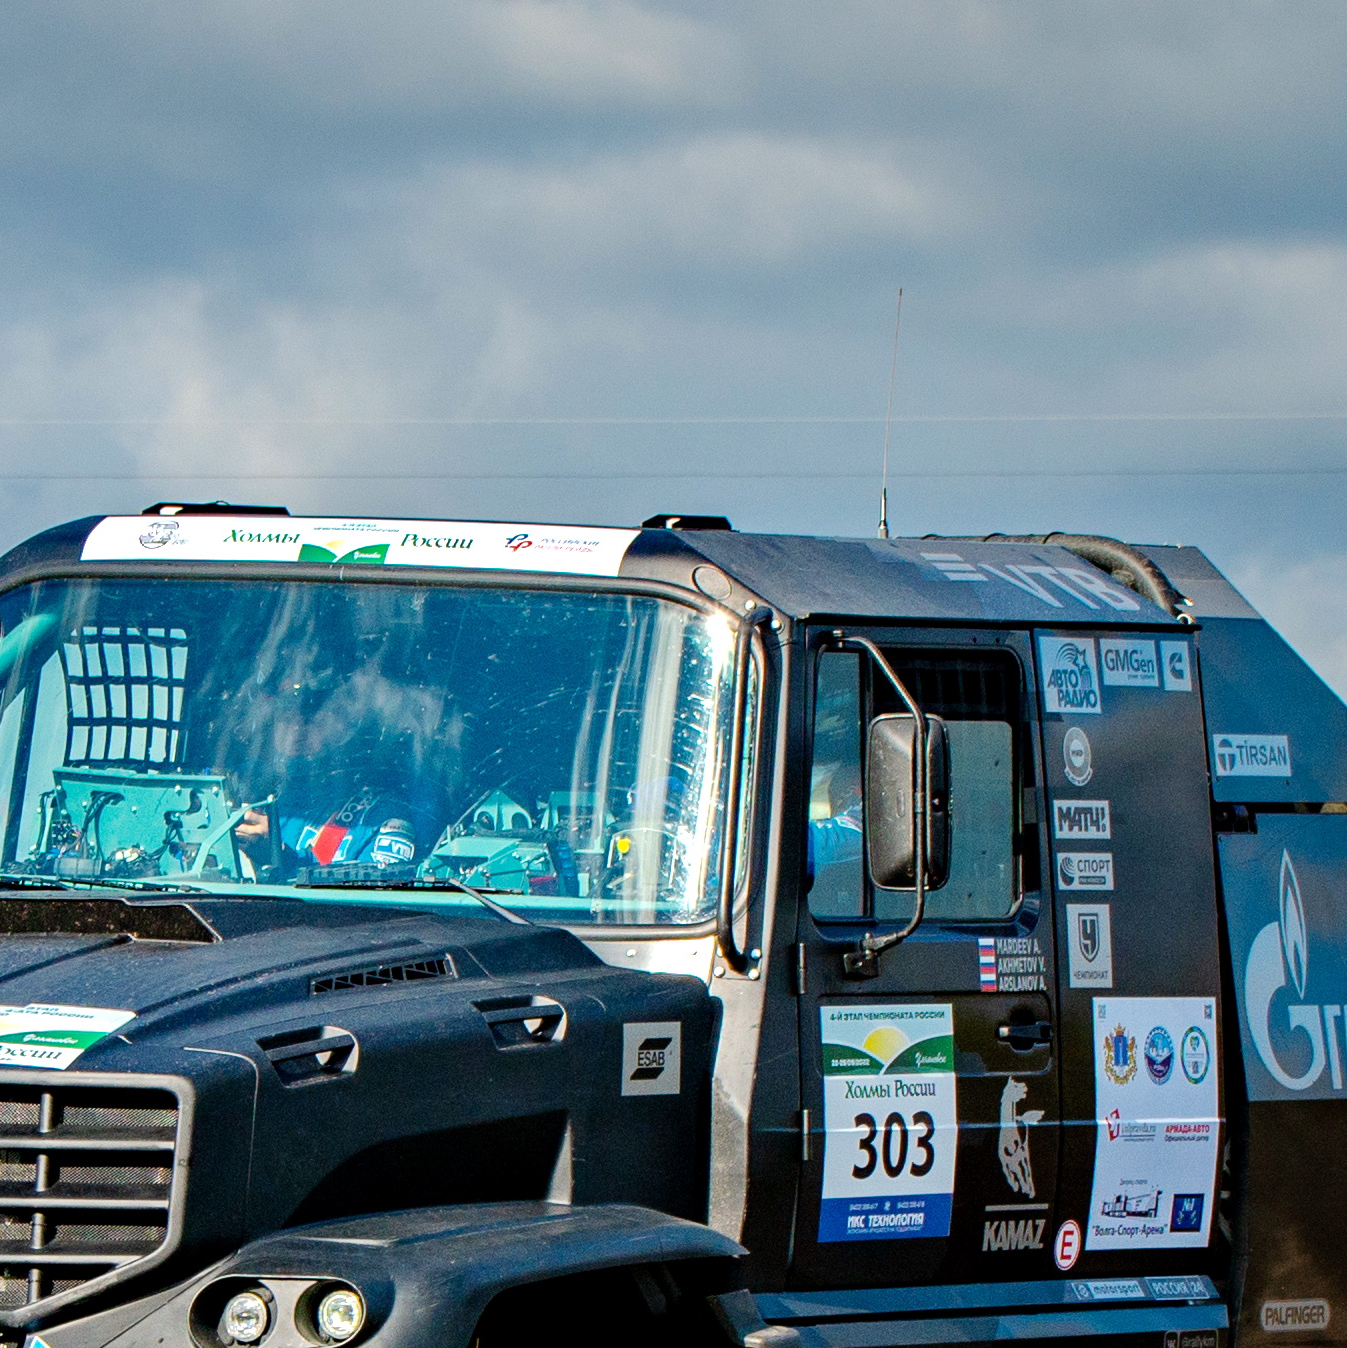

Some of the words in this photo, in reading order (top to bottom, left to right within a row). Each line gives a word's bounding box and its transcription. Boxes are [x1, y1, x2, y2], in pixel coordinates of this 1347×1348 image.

[223, 529, 300, 544] Холмы
[401, 533, 473, 549] России
[977, 564, 1141, 611] VTB
[1105, 649, 1155, 673] GMGen
[1047, 669, 1080, 689] АВТО
[1057, 689, 1098, 708] РАДИО
[1057, 806, 1106, 832] МАТЧ!
[1077, 859, 1110, 873] СПОРТ
[844, 1012, 863, 1021] ЭТАП
[864, 1011, 914, 1021] ЧЕМПИОНАТА
[914, 1011, 944, 1020] РОССИИ
[637, 1051, 666, 1066] ESAB
[845, 1081, 891, 1098] Холмы
[894, 1080, 936, 1097] России
[852, 1110, 935, 1180] 303
[868, 1212, 925, 1227] ТЕХНОЛОГИЯ
[982, 1219, 1046, 1251] KAMAZ
[1060, 1230, 1074, 1260] E
[1093, 1283, 1141, 1297] motorsport
[1153, 1282, 1188, 1295] РОССИЯ
[1191, 1282, 1205, 1294] 24
[1265, 1304, 1325, 1325] PALFINGER
